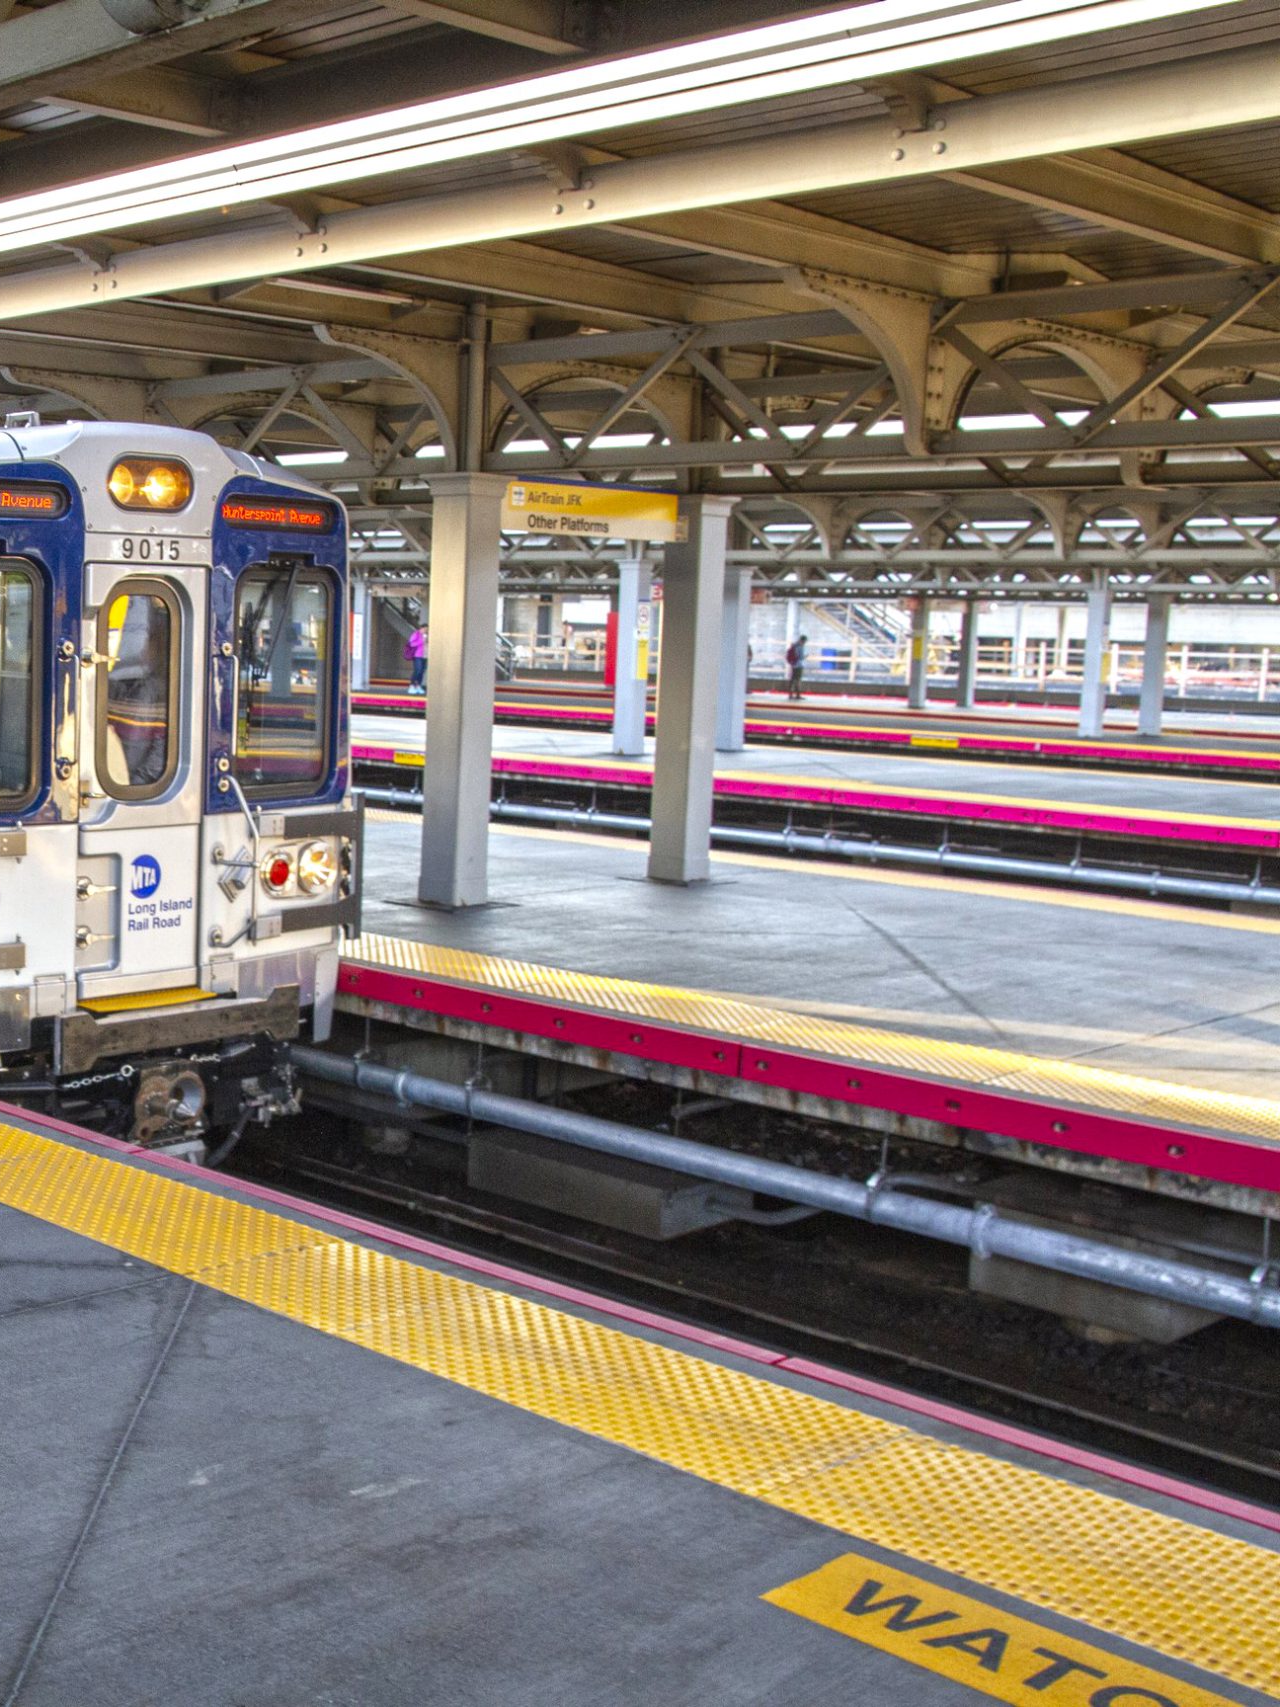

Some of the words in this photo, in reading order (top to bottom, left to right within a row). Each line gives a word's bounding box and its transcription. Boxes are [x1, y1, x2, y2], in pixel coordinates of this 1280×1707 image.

[1, 490, 53, 508] Avenue
[528, 491, 564, 505] AirTrain
[566, 494, 582, 506] JFK
[222, 504, 285, 522] Hunterspoint
[288, 508, 322, 524] Avenue
[527, 514, 558, 528] Other
[560, 517, 609, 533] Platforms
[122, 538, 180, 561] 9015
[129, 864, 156, 891] MTA
[128, 903, 156, 916] Long
[159, 897, 192, 912] Island
[128, 918, 149, 931] Rail
[152, 915, 181, 929] Road
